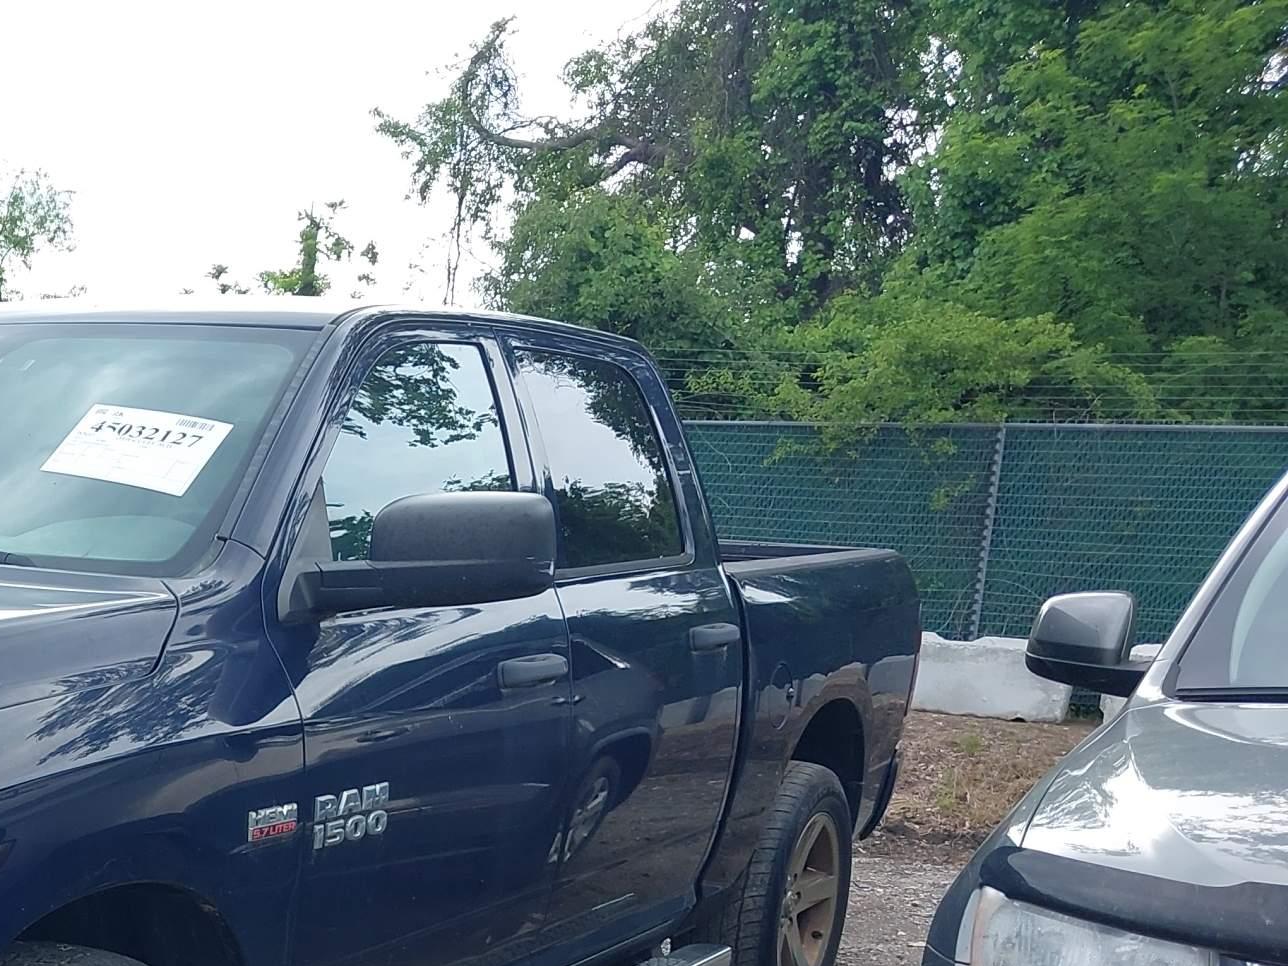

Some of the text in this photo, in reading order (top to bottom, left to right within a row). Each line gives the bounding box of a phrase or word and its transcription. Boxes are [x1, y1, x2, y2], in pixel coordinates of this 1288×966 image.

[90, 419, 205, 448] 45032127
[315, 782, 389, 820] RAM
[253, 821, 297, 839] 5.7 LITER
[313, 810, 388, 849] 1500
